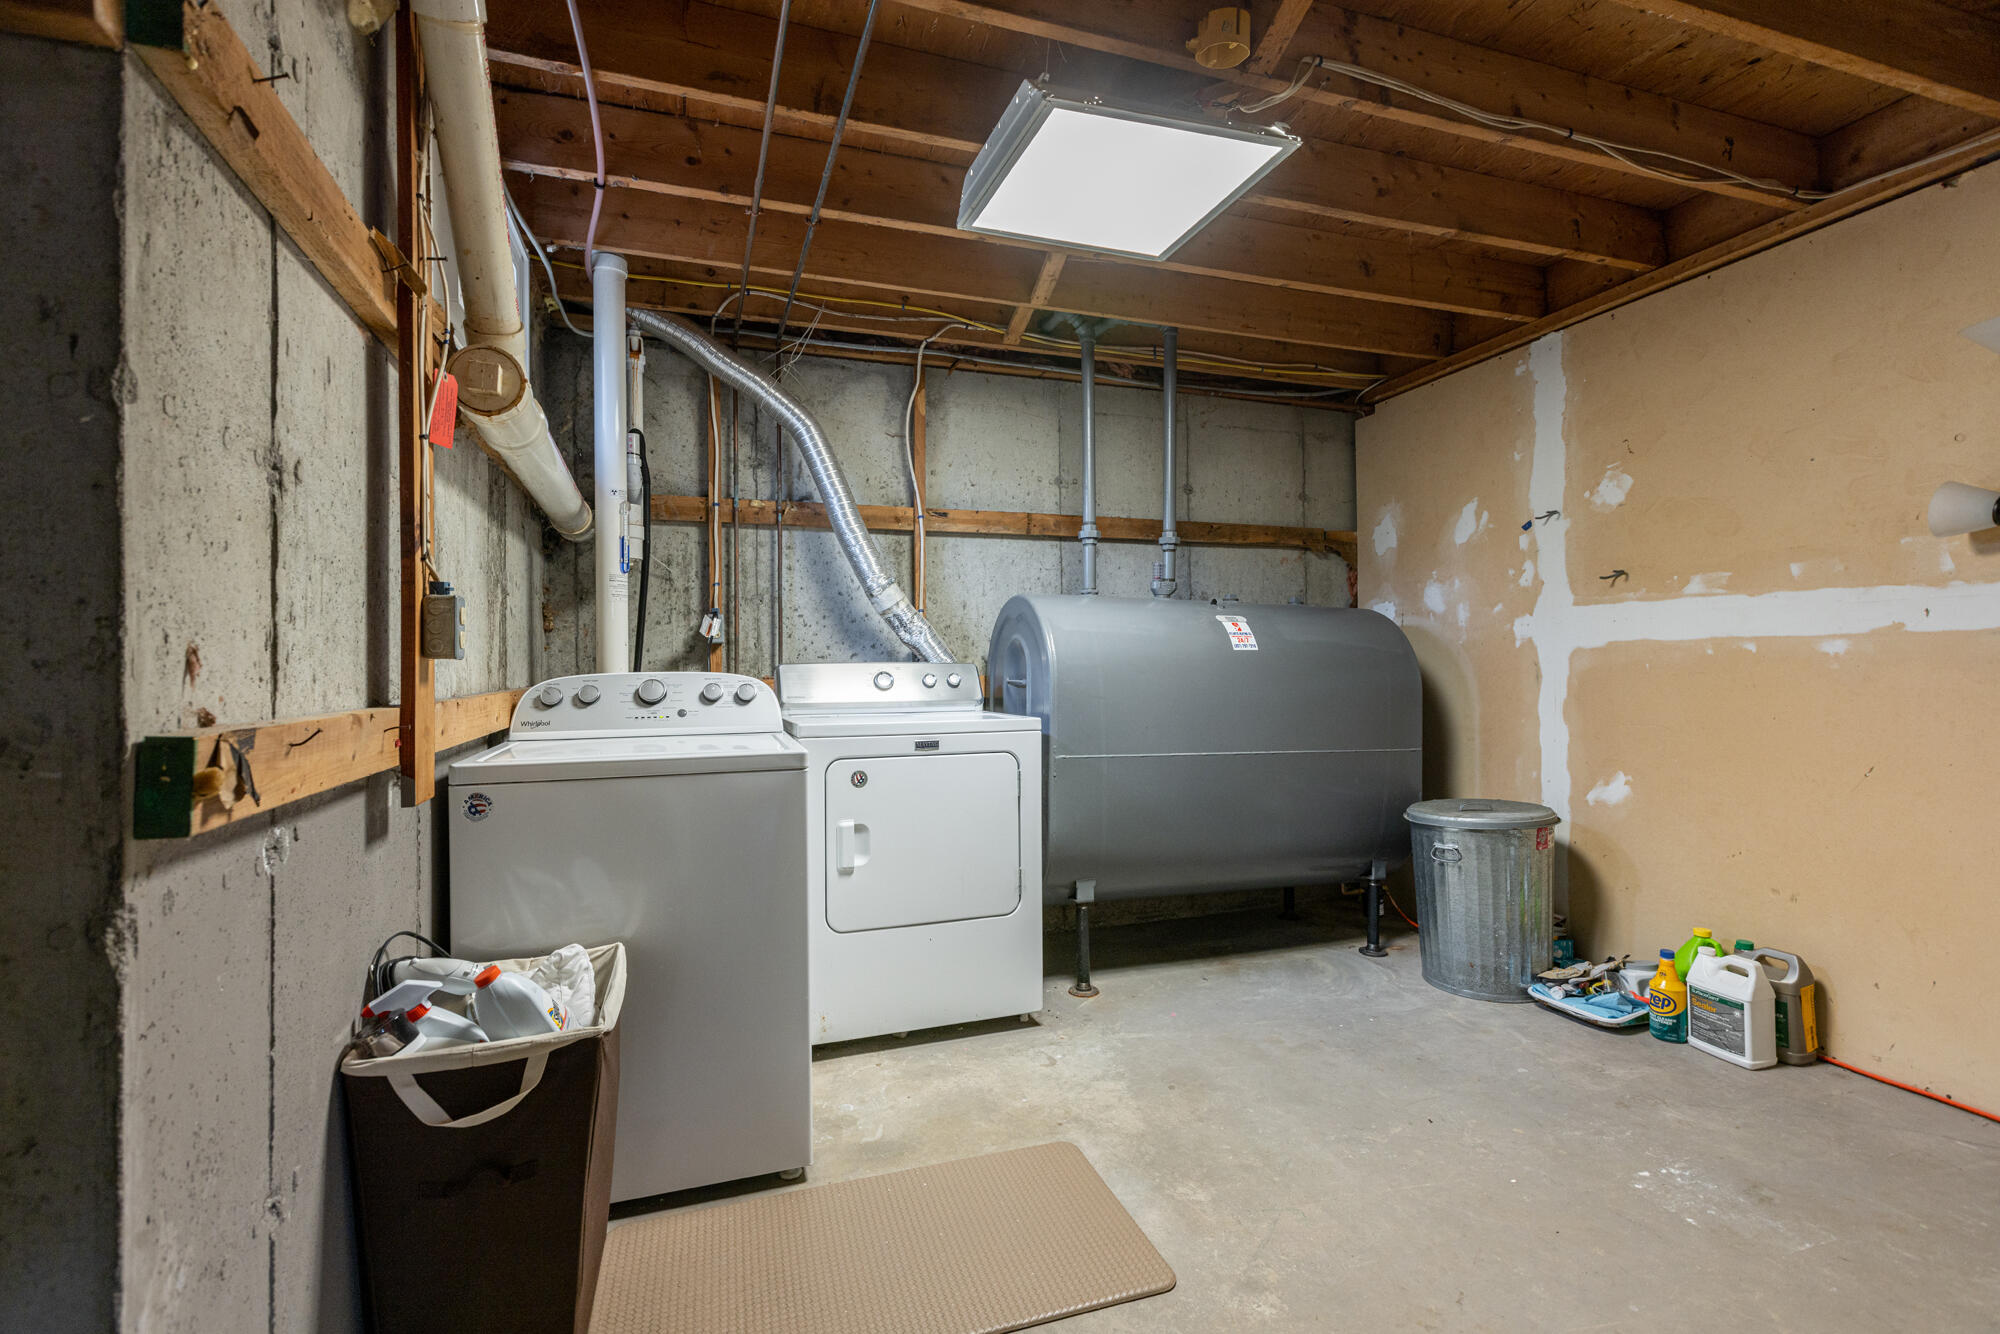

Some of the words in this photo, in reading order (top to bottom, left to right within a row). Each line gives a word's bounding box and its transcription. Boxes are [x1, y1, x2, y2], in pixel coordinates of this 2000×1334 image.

[520, 720, 551, 729] Whirlpool
[464, 793, 492, 806] AMERICA
[1691, 997, 1717, 1013] Sealer
